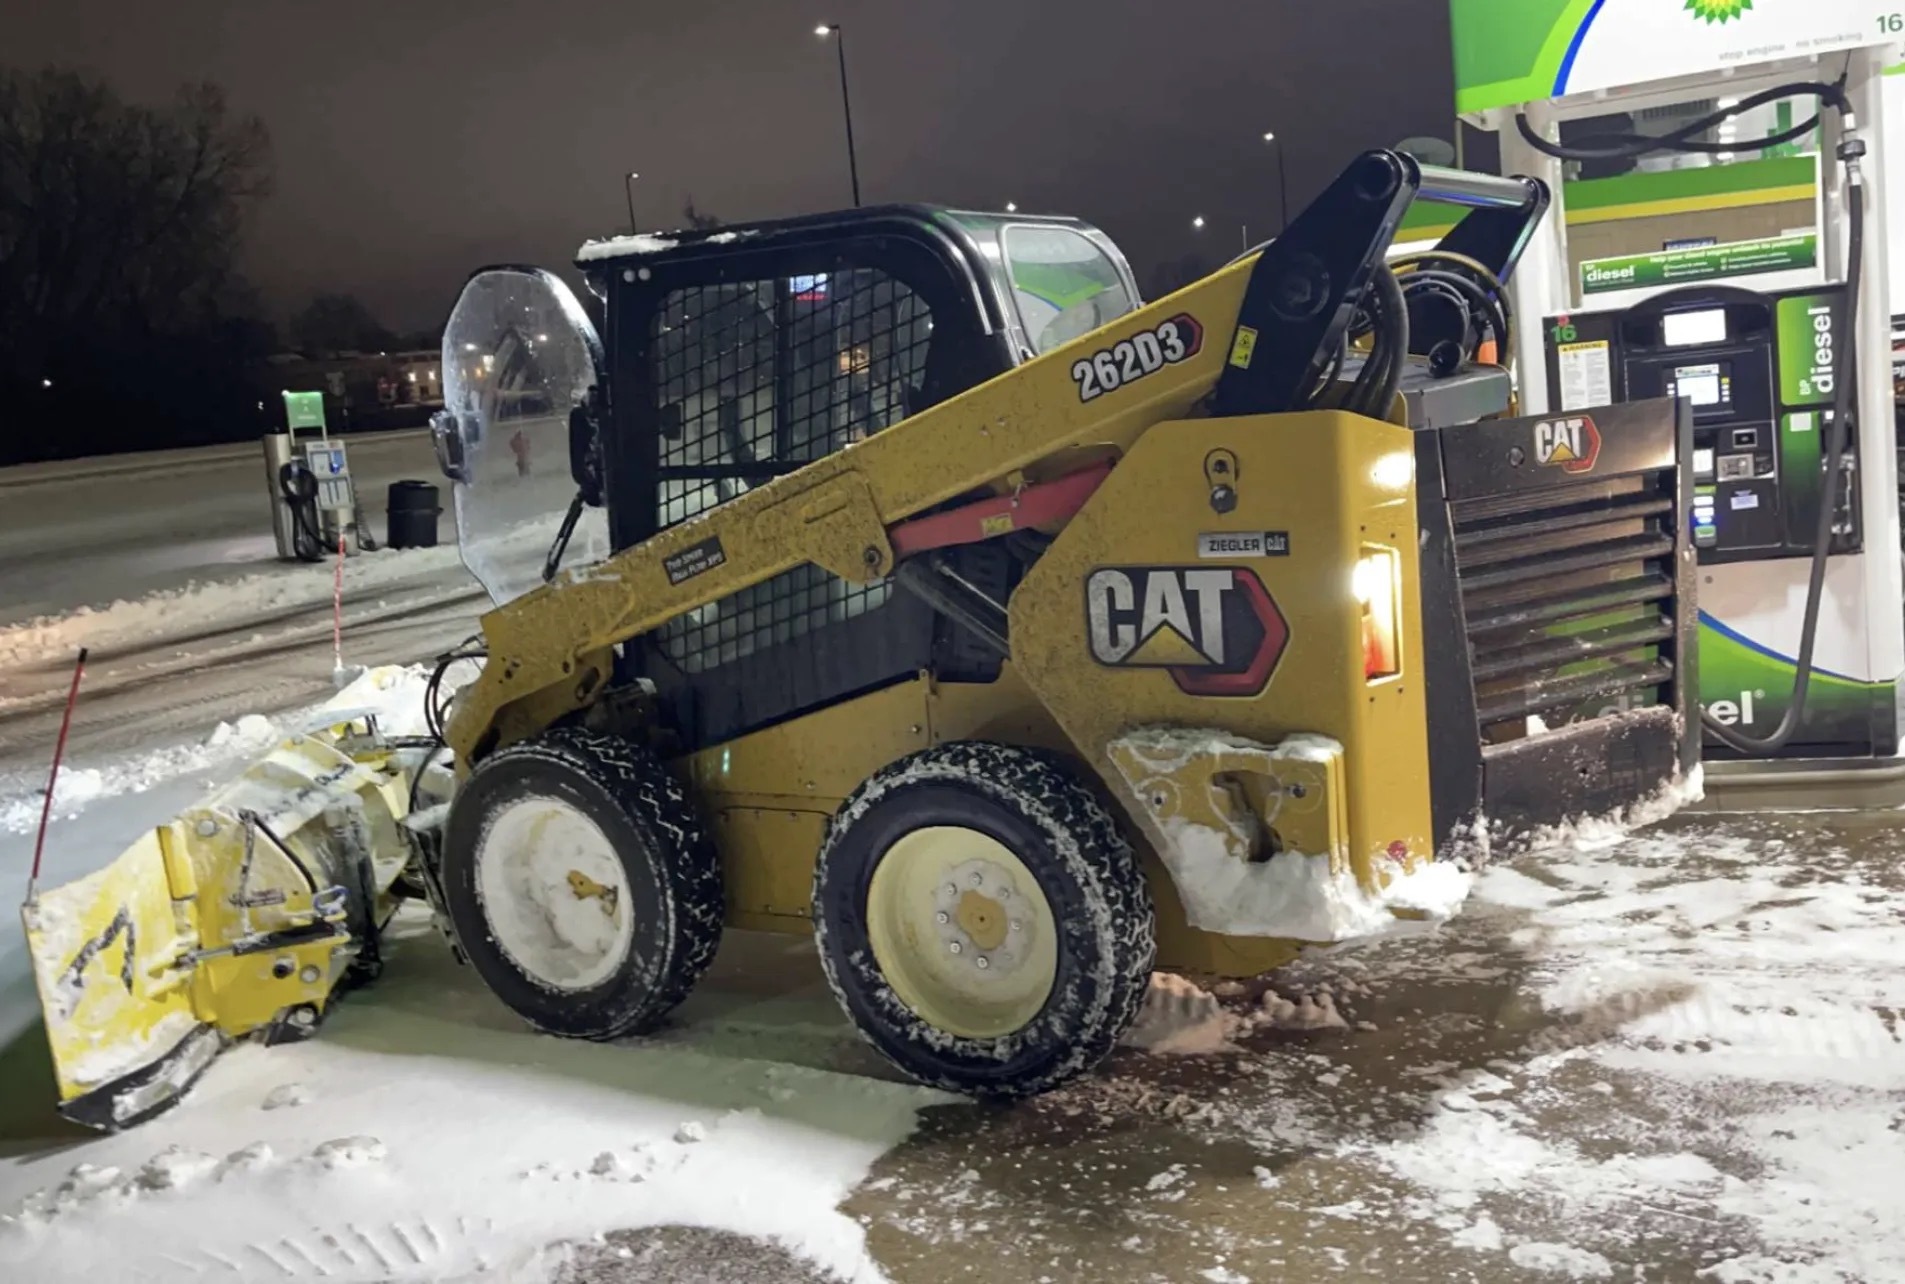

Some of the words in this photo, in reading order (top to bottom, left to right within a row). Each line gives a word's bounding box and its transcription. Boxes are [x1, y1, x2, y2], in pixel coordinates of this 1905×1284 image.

[1876, 13, 1904, 33] 16
[1719, 49, 1743, 60] stop
[1747, 43, 1786, 56] engine
[1813, 32, 1863, 46] smoking
[1586, 265, 1635, 281] diesel
[1551, 324, 1577, 343] 16
[1073, 321, 1186, 401] 262D3
[1807, 306, 1834, 393] diesel
[1799, 379, 1811, 396] BP
[1535, 418, 1584, 463] CAT
[1208, 538, 1260, 552] ZIEGLER
[1088, 569, 1233, 664] CAT
